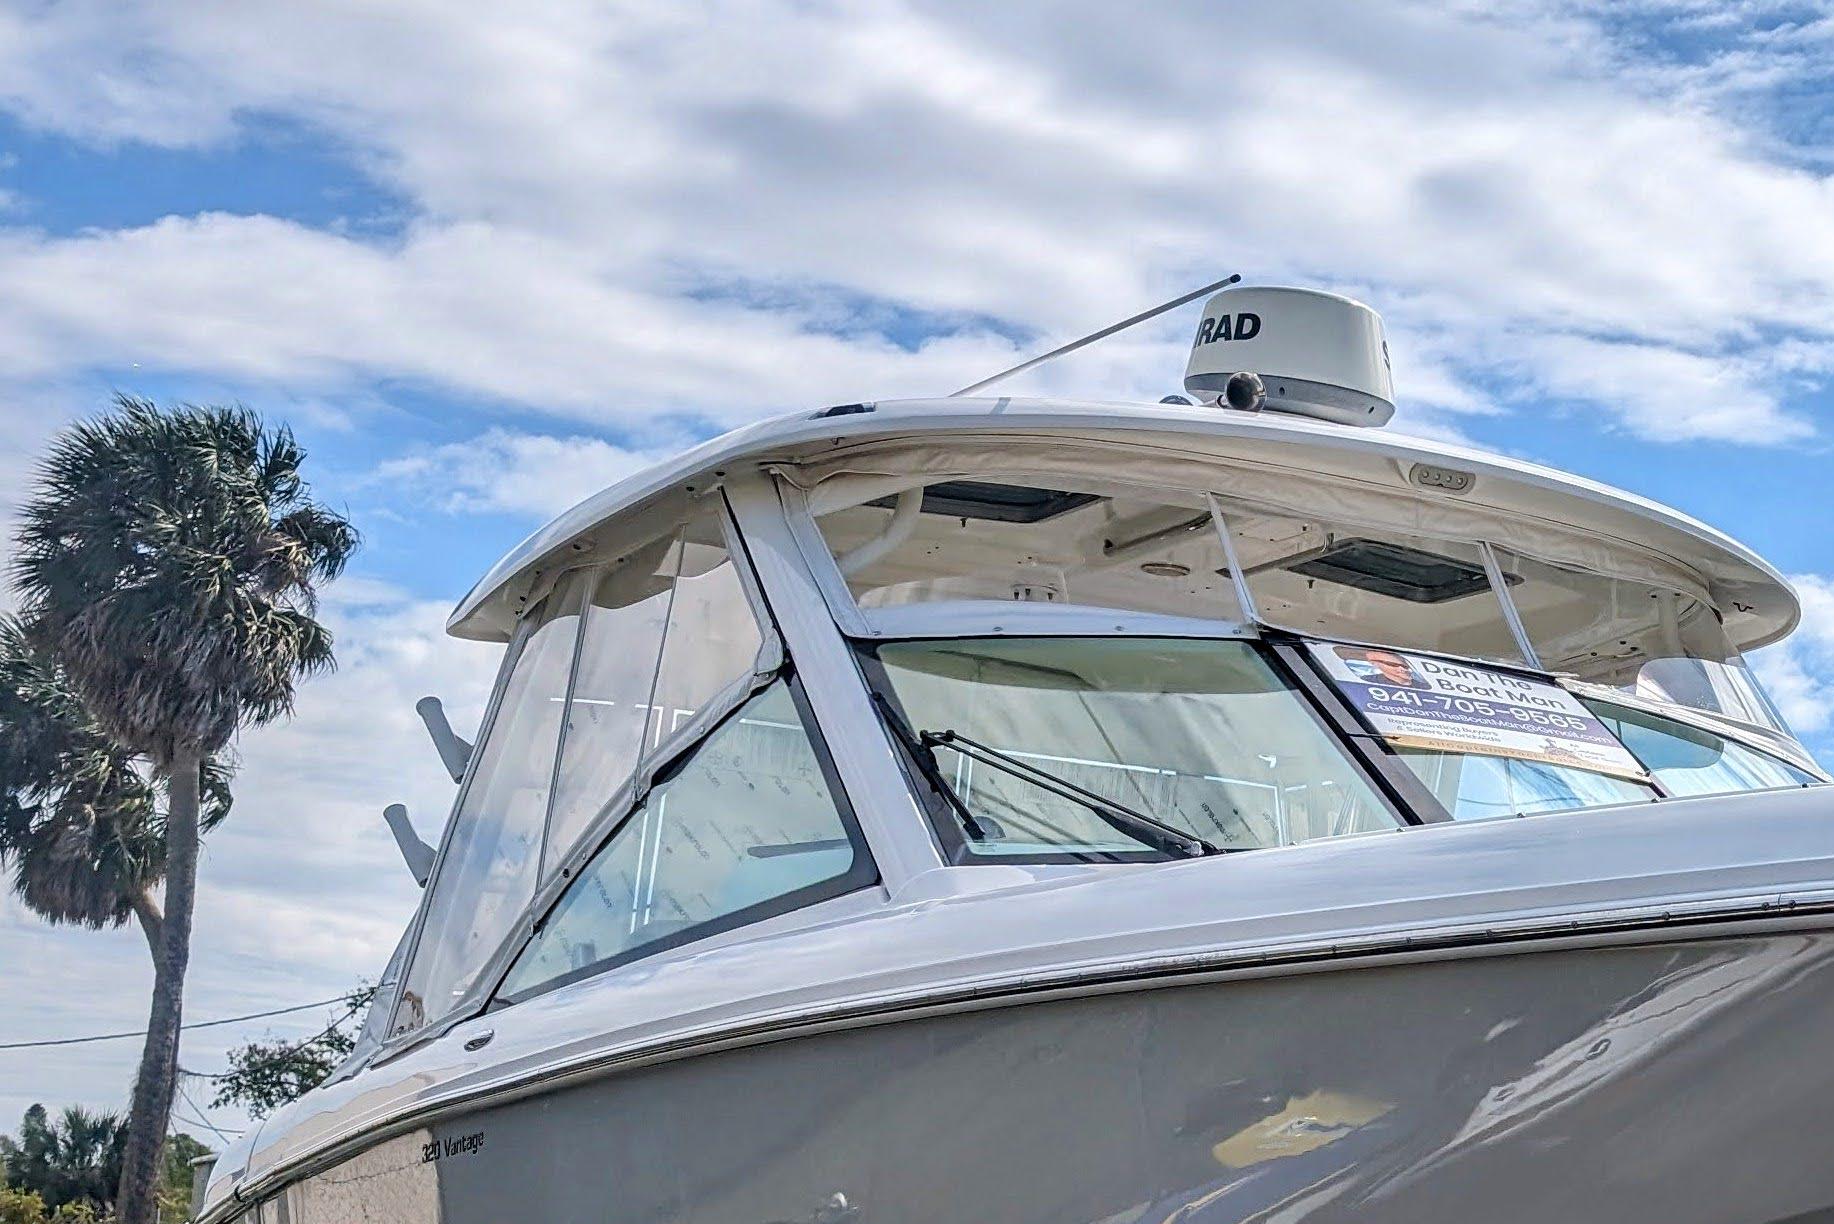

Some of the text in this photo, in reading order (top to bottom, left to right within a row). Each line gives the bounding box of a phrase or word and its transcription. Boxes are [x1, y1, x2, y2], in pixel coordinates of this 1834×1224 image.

[1194, 312, 1262, 348] RAD
[1421, 661, 1533, 691] Dan The
[1367, 687, 1587, 731] 941-705-9565
[1436, 678, 1567, 709] Boat Man
[422, 1131, 484, 1163] 320 Vantage
